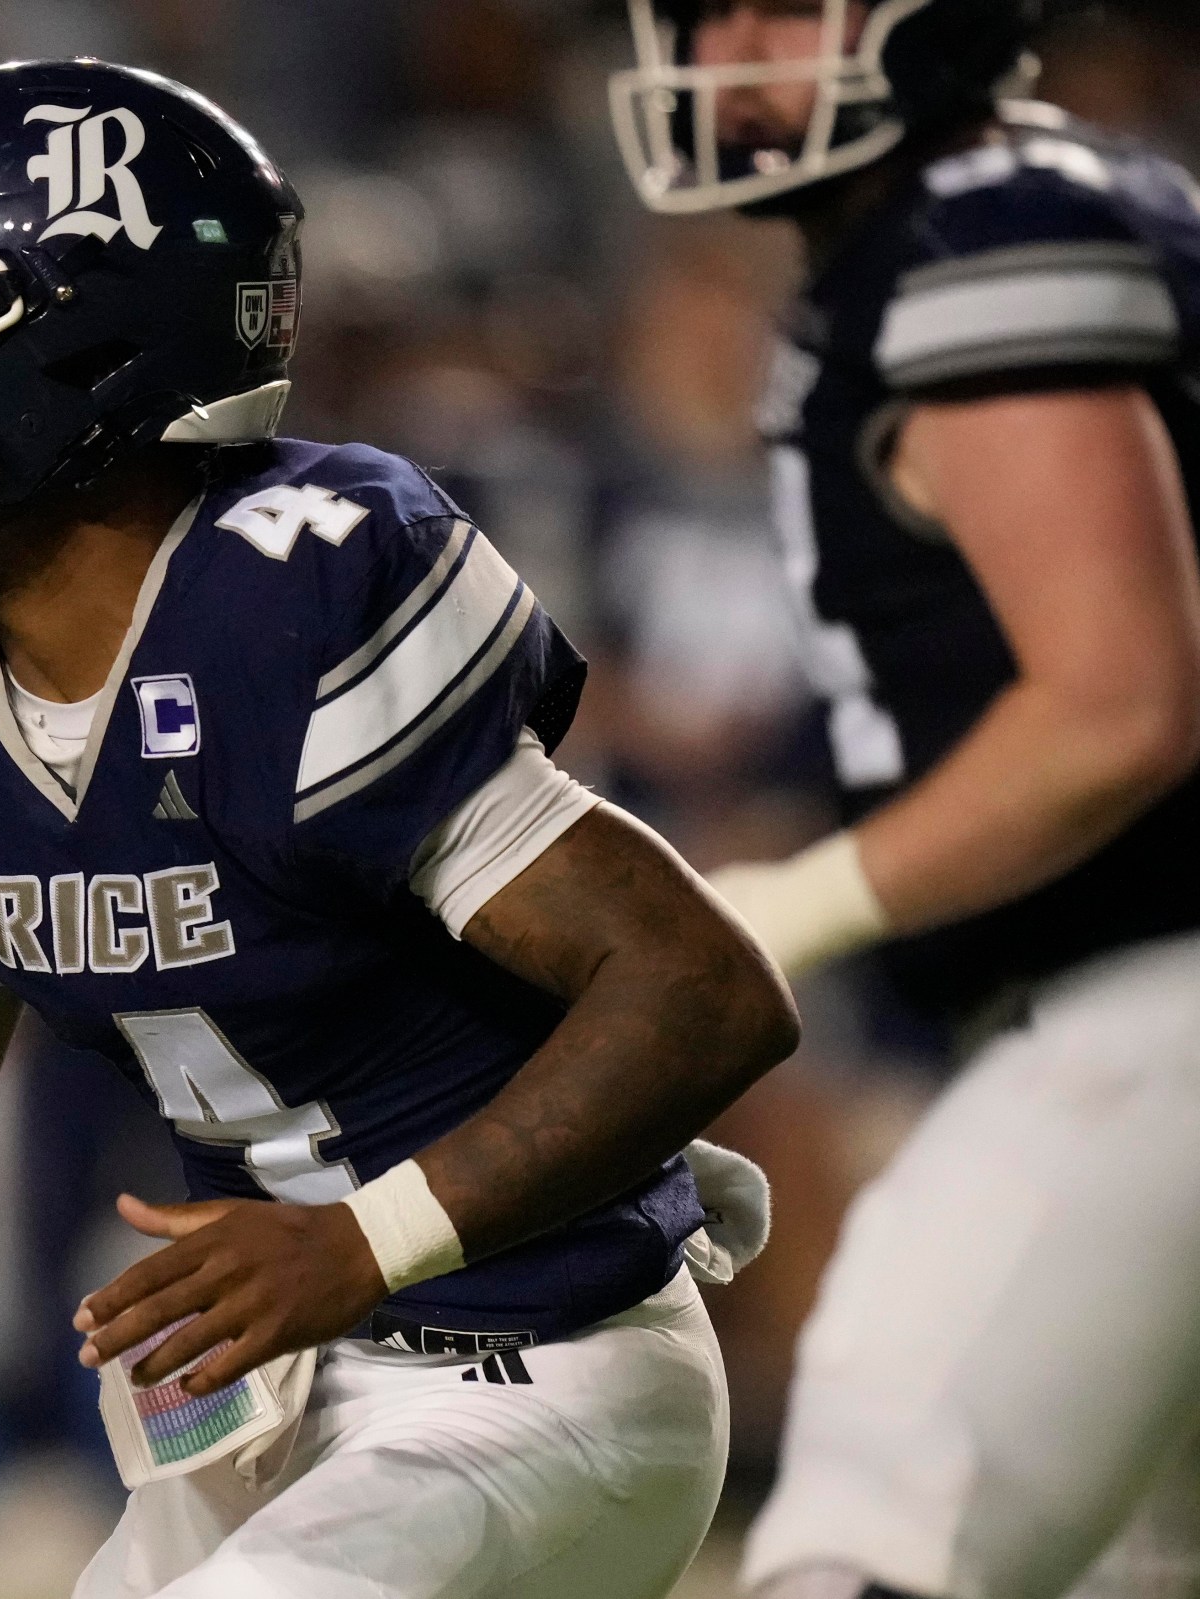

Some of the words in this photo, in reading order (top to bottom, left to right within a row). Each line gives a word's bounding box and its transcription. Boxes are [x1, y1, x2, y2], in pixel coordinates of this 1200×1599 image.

[23, 104, 164, 250] R
[245, 295, 263, 312] OWL
[249, 313, 259, 330] IN
[213, 483, 371, 562] 4
[138, 679, 198, 754] C
[112, 1006, 363, 1206] 4
